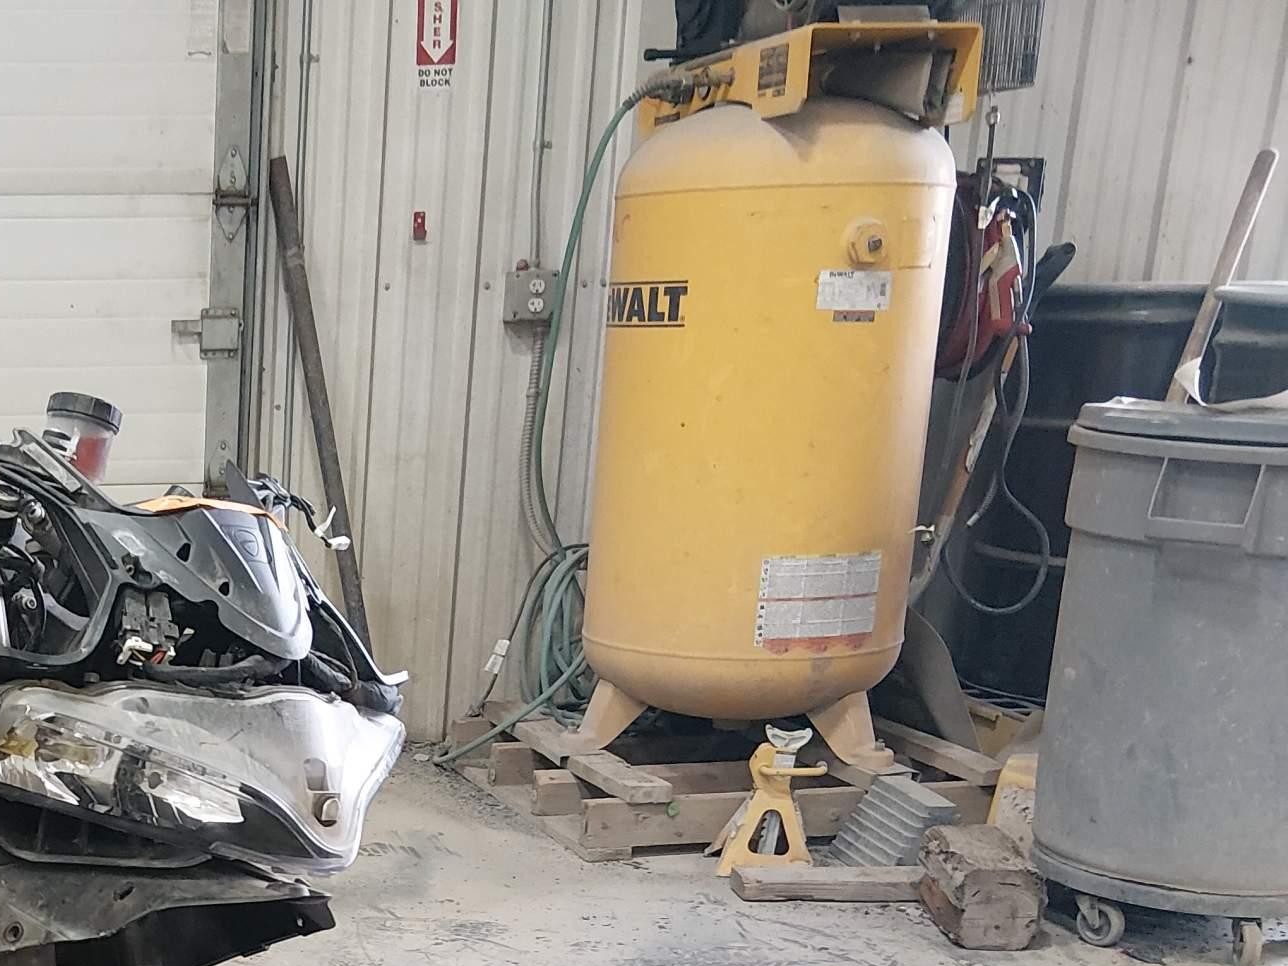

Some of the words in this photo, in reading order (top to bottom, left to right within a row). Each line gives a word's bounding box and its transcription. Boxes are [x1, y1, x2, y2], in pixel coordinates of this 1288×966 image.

[418, 69, 431, 78] DO
[433, 68, 453, 77] NOT
[419, 78, 451, 88] BLOCK
